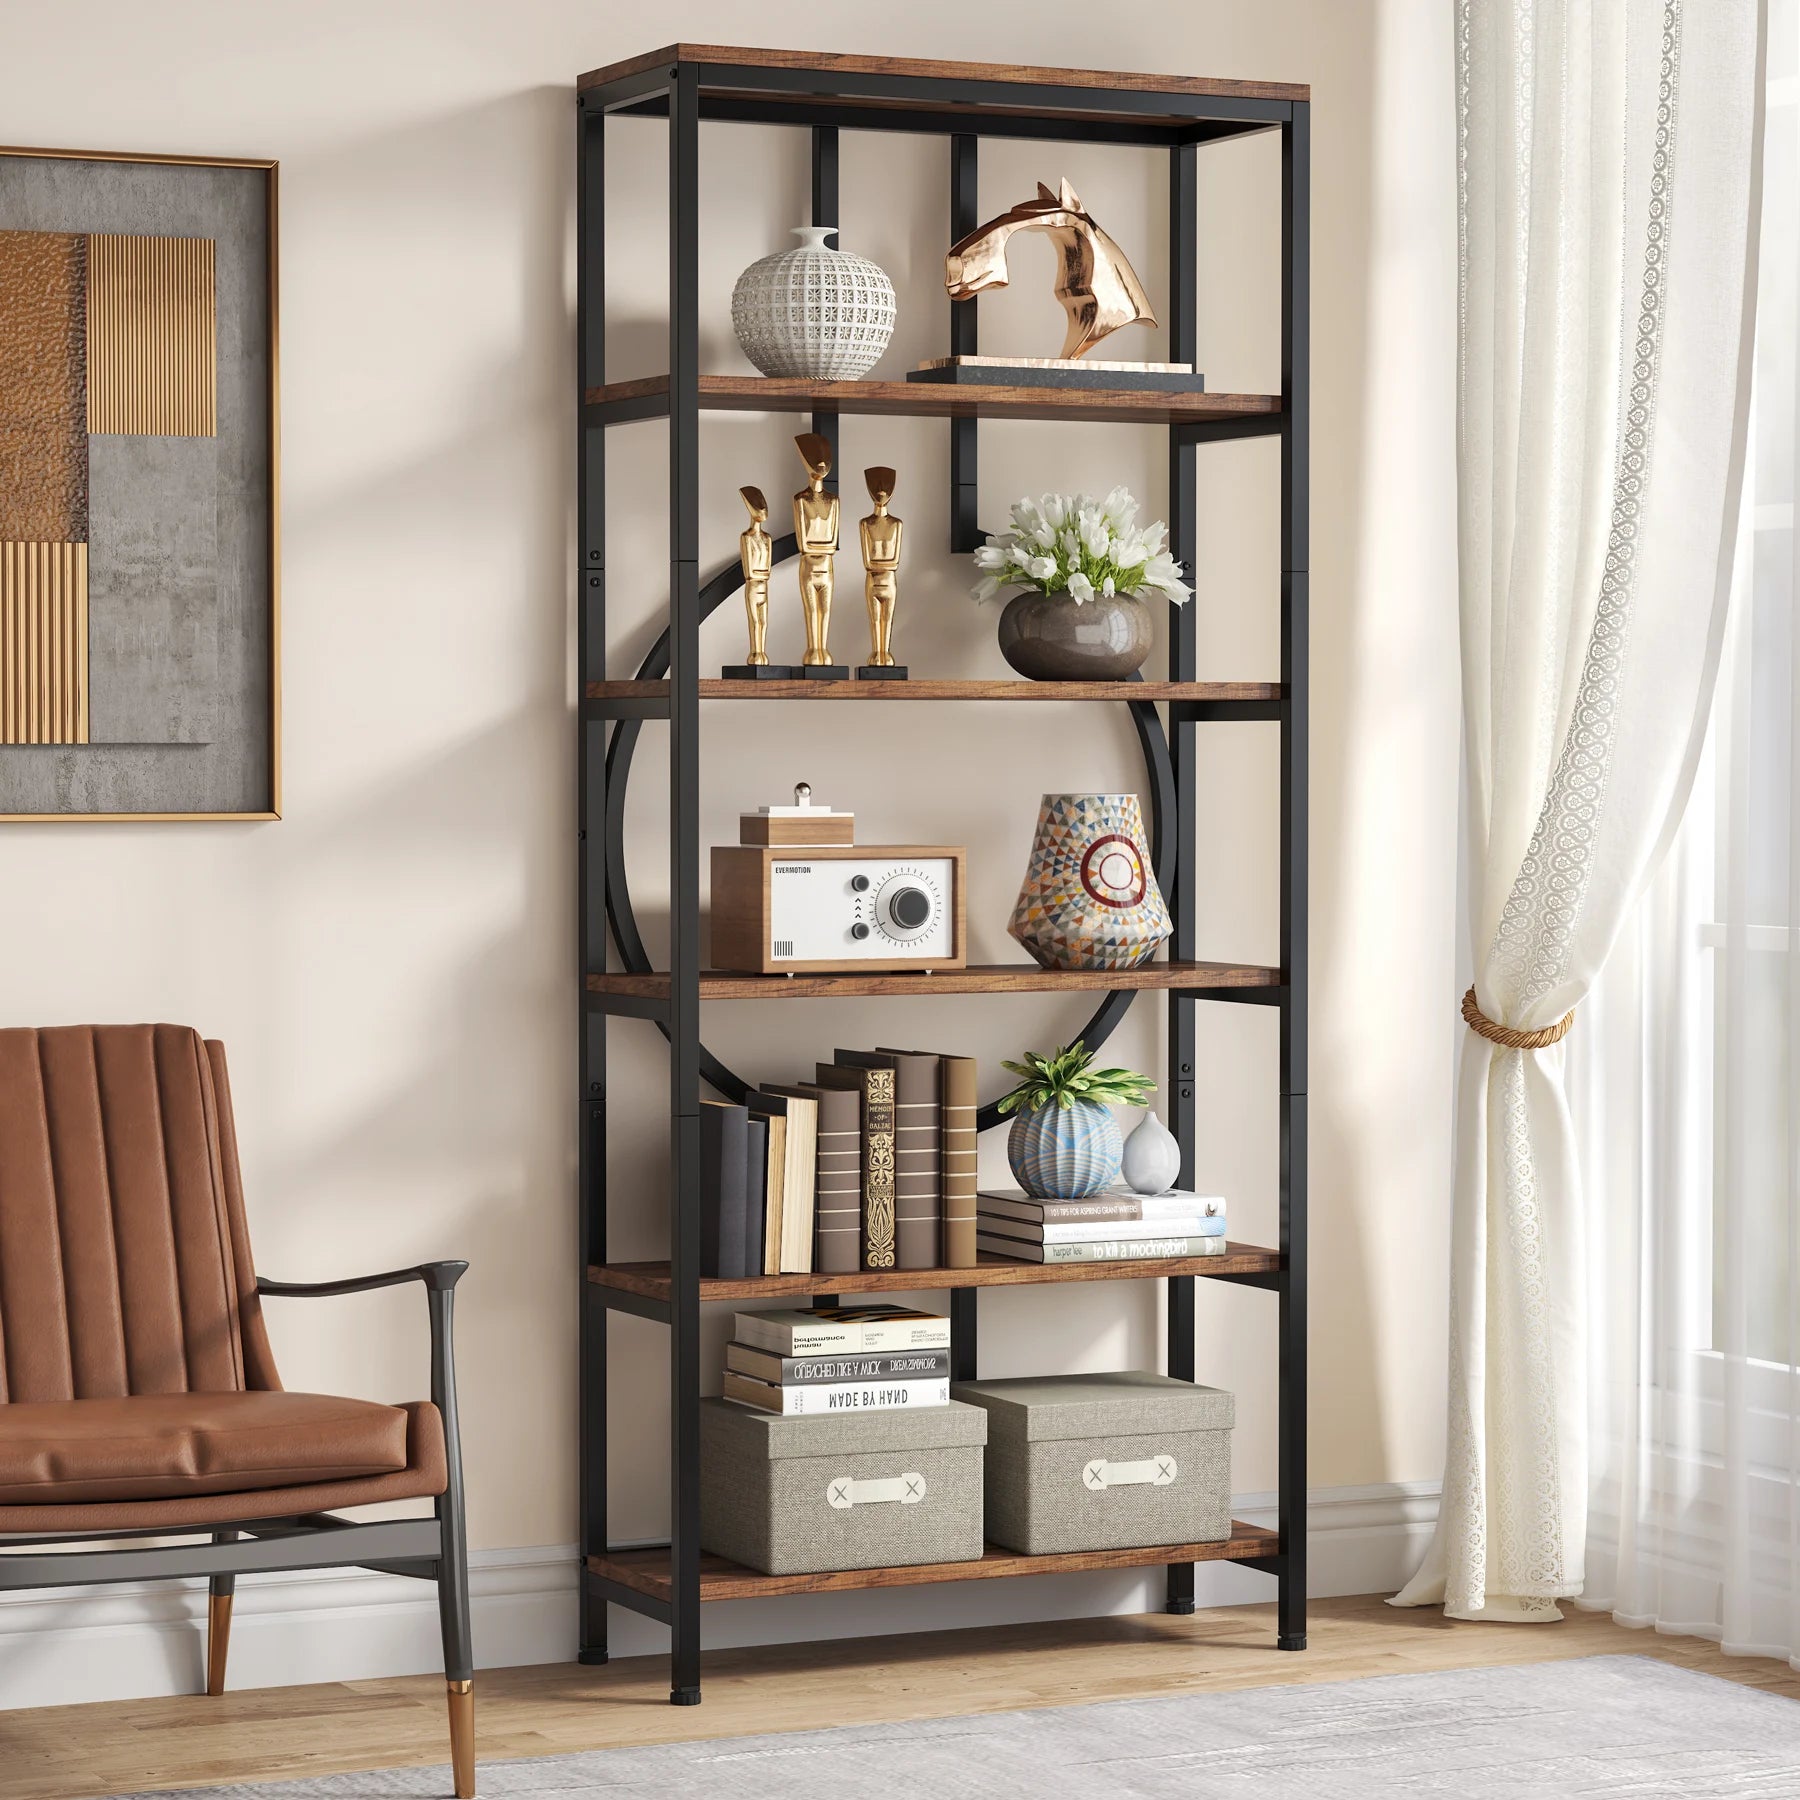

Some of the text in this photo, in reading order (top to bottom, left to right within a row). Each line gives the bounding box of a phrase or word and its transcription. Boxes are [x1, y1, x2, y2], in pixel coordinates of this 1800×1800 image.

[1060, 1208, 1069, 1216] TIPS
[1070, 1207, 1079, 1215] FOR
[1102, 1205, 1118, 1214] GRANT
[1052, 1239, 1187, 1259] harper lee to kill a mockingbird
